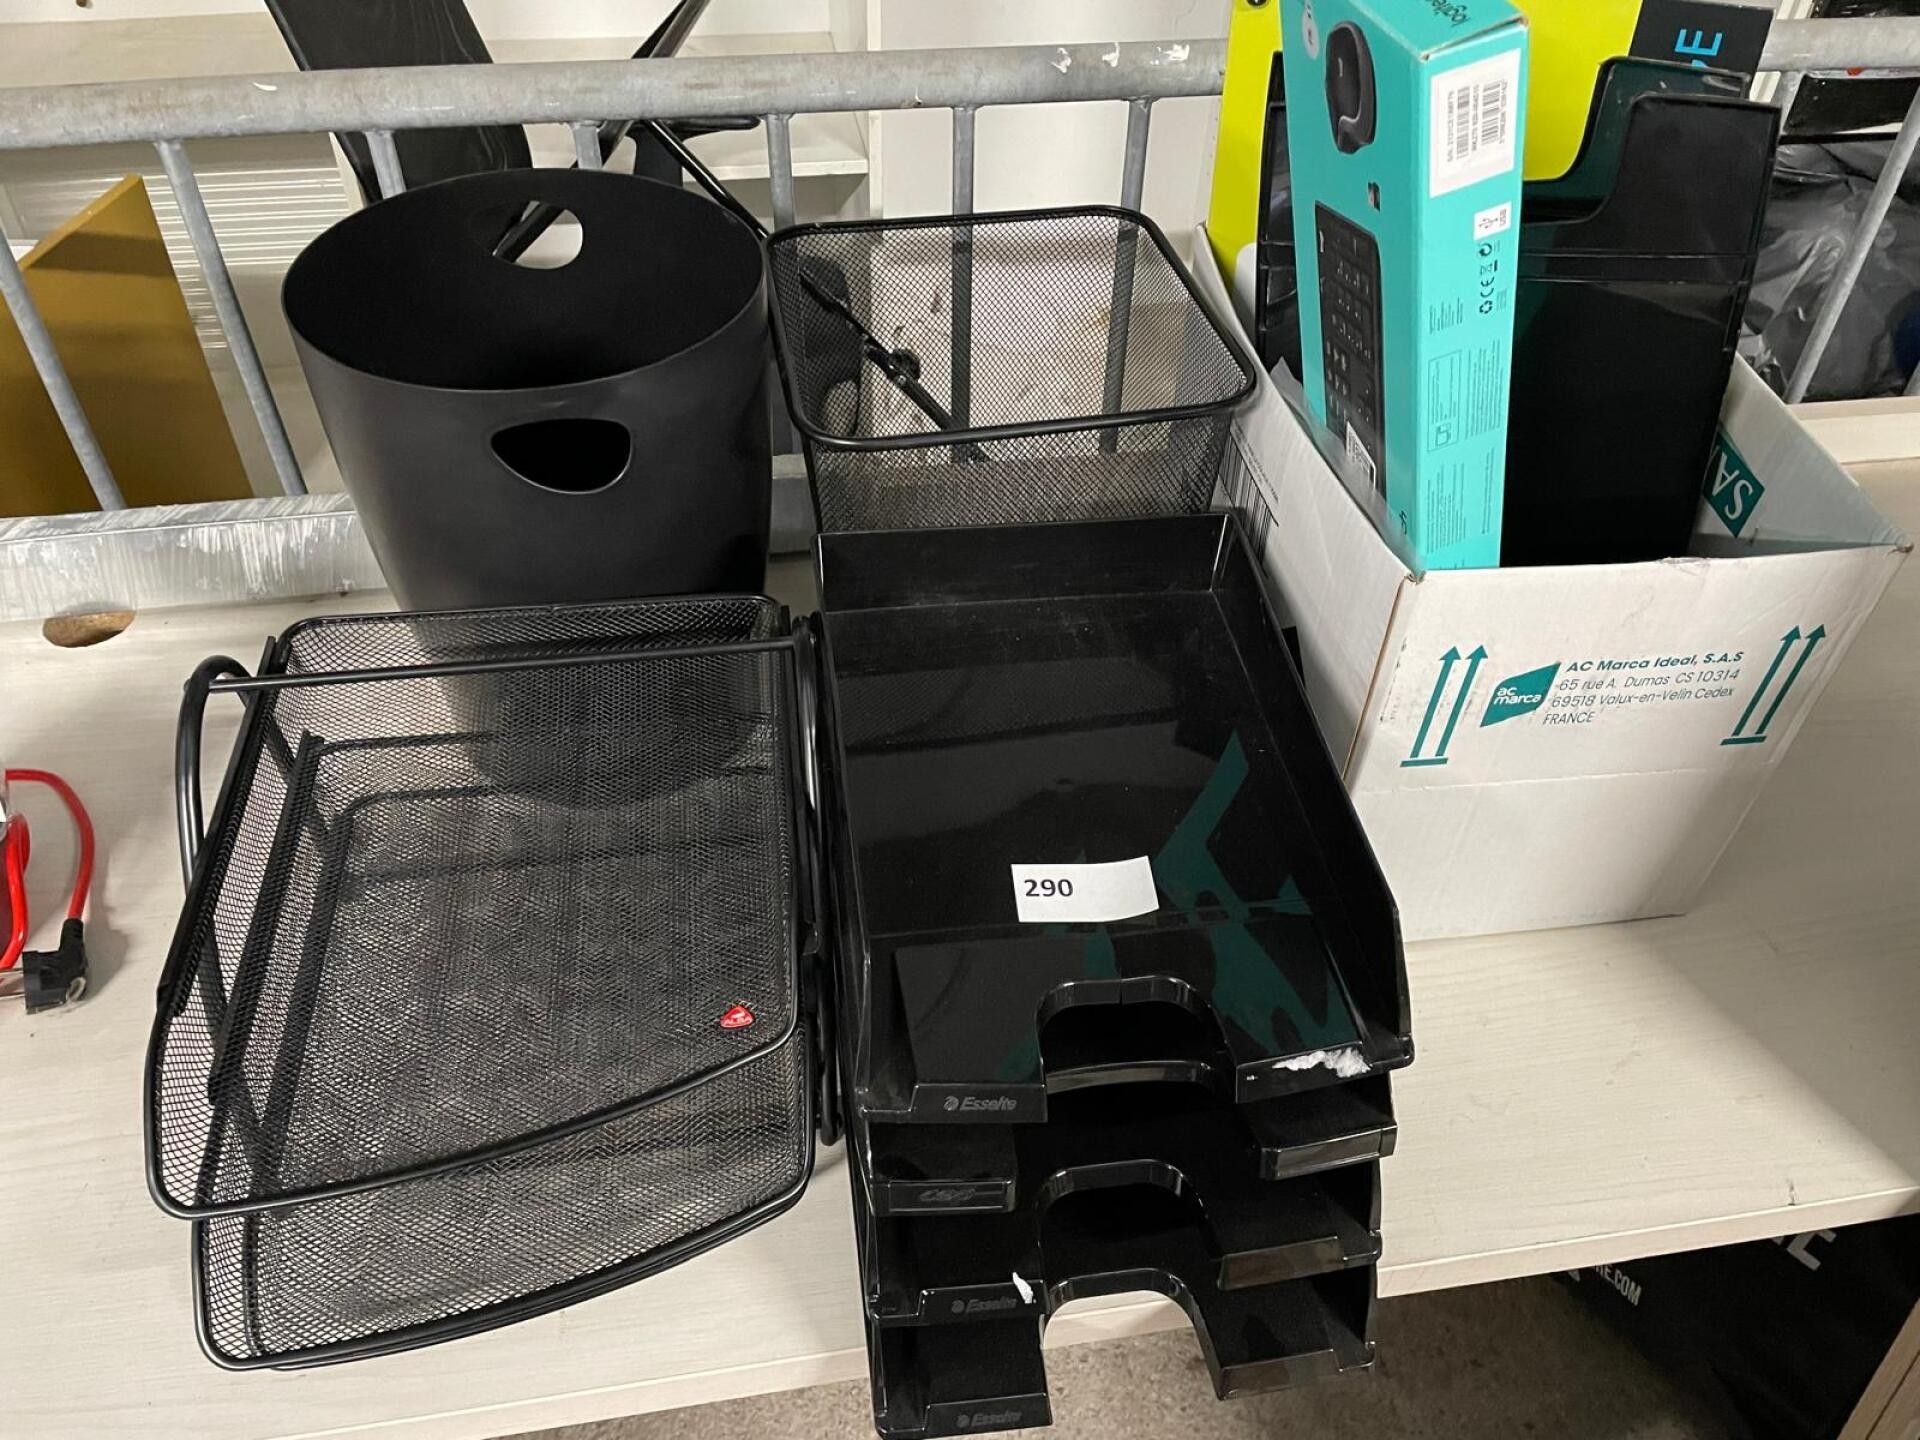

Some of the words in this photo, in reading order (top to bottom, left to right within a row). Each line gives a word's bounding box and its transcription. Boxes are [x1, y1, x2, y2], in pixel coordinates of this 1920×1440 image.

[1674, 28, 1723, 69] E
[1566, 661, 1593, 673] AC
[1596, 659, 1650, 671] Marca
[1654, 654, 1698, 668] Ideal,
[1559, 678, 1579, 691] 65
[1582, 680, 1604, 690] rue
[1624, 676, 1671, 688] Dumas
[1675, 671, 1695, 684] CS
[1697, 669, 1740, 684] 10314
[1493, 694, 1542, 705] marca
[1497, 686, 1517, 696] ac
[1551, 694, 1596, 708] 69518
[1694, 686, 1735, 700] Cedex
[1542, 711, 1596, 725] FRANCE
[1023, 878, 1074, 898] 290
[959, 1095, 1018, 1111] Esselte
